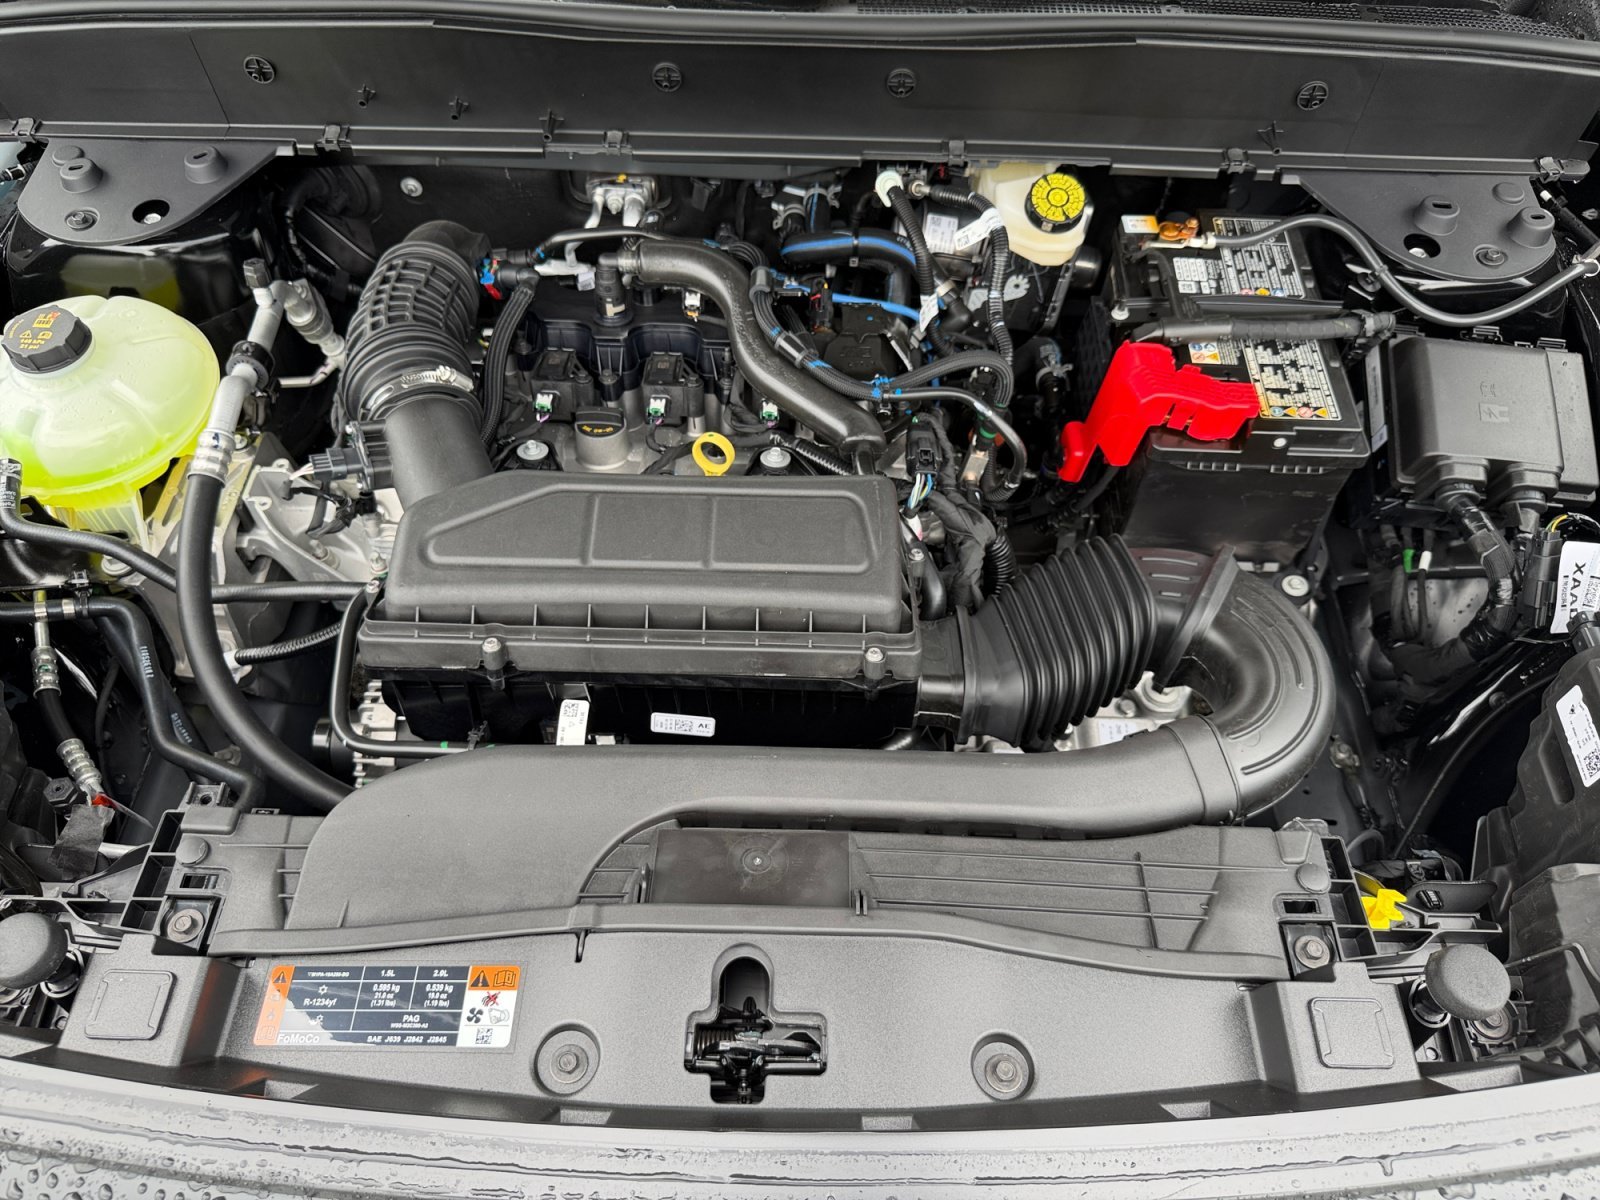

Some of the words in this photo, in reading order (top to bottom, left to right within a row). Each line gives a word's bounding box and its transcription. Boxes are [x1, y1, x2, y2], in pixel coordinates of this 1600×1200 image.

[381, 969, 396, 977] 1.5L
[433, 969, 449, 977] 2.0L
[391, 984, 401, 993] kg
[425, 984, 444, 992] 0.539
[444, 984, 454, 993] kg
[303, 998, 338, 1007] R-1234yf
[277, 1033, 320, 1043] FoMoCo
[367, 1035, 382, 1043] SAE
[384, 1035, 402, 1043] J639
[403, 1035, 424, 1043] J2842
[427, 1035, 448, 1043] J2845
